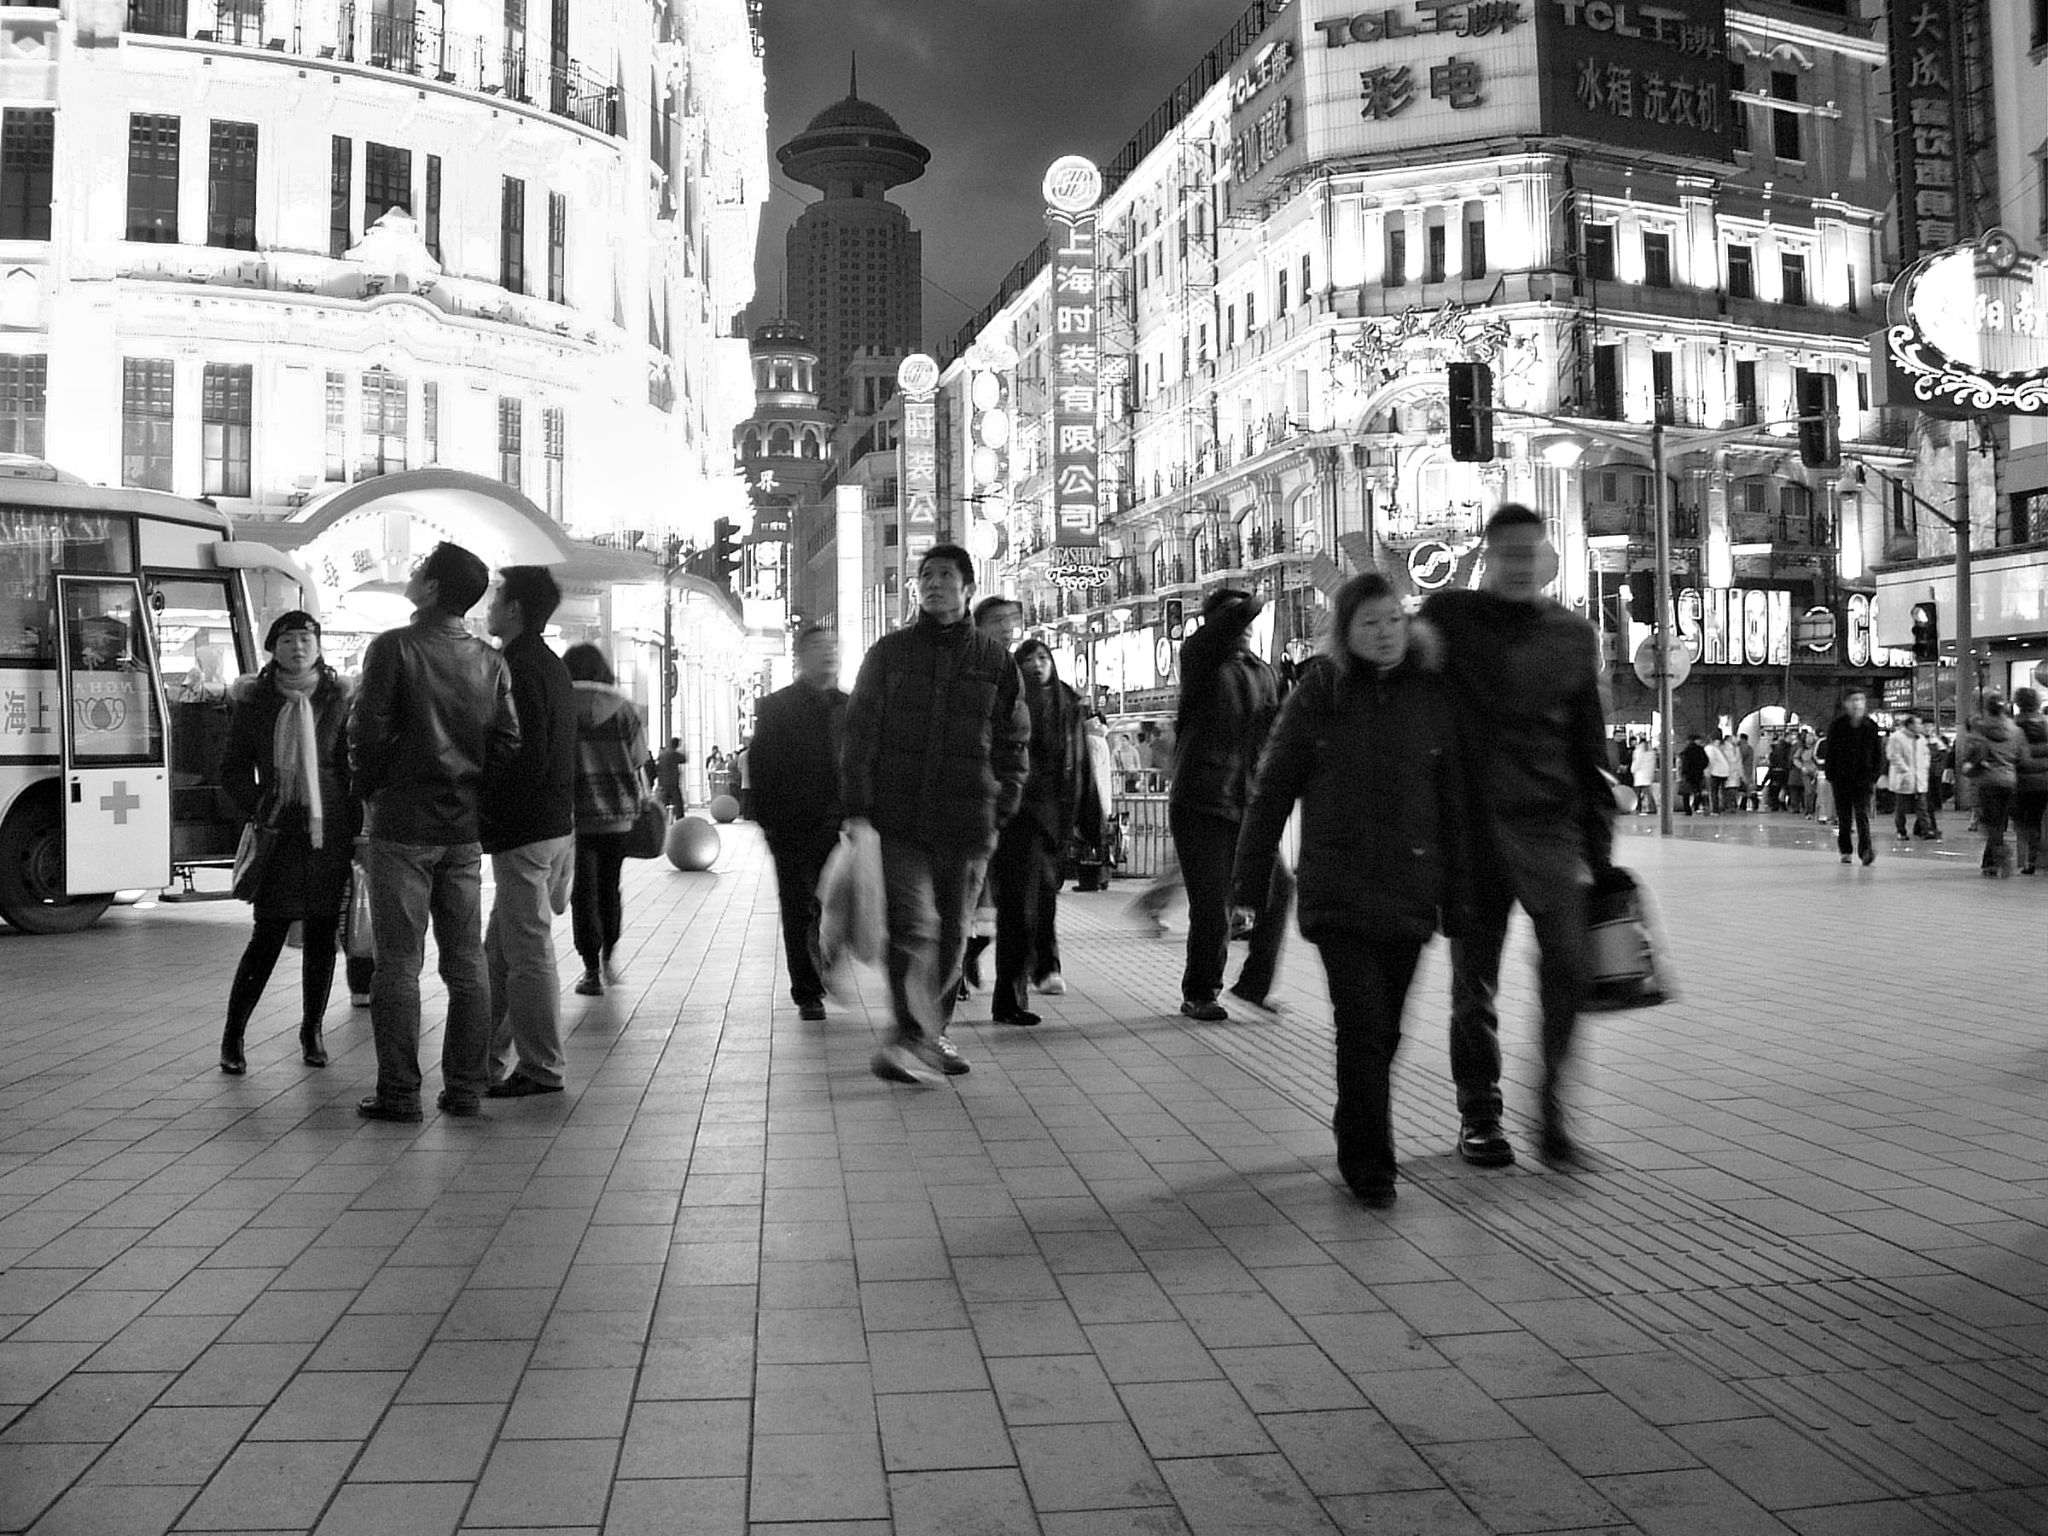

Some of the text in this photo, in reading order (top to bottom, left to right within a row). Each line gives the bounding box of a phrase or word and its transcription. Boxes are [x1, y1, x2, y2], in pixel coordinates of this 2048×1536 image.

[1314, 0, 1528, 48] TCL王牌
[1554, 0, 1723, 60] TCL王牌
[1360, 56, 1487, 120] 彩电
[1056, 226, 1098, 536] 上海时装有限公司
